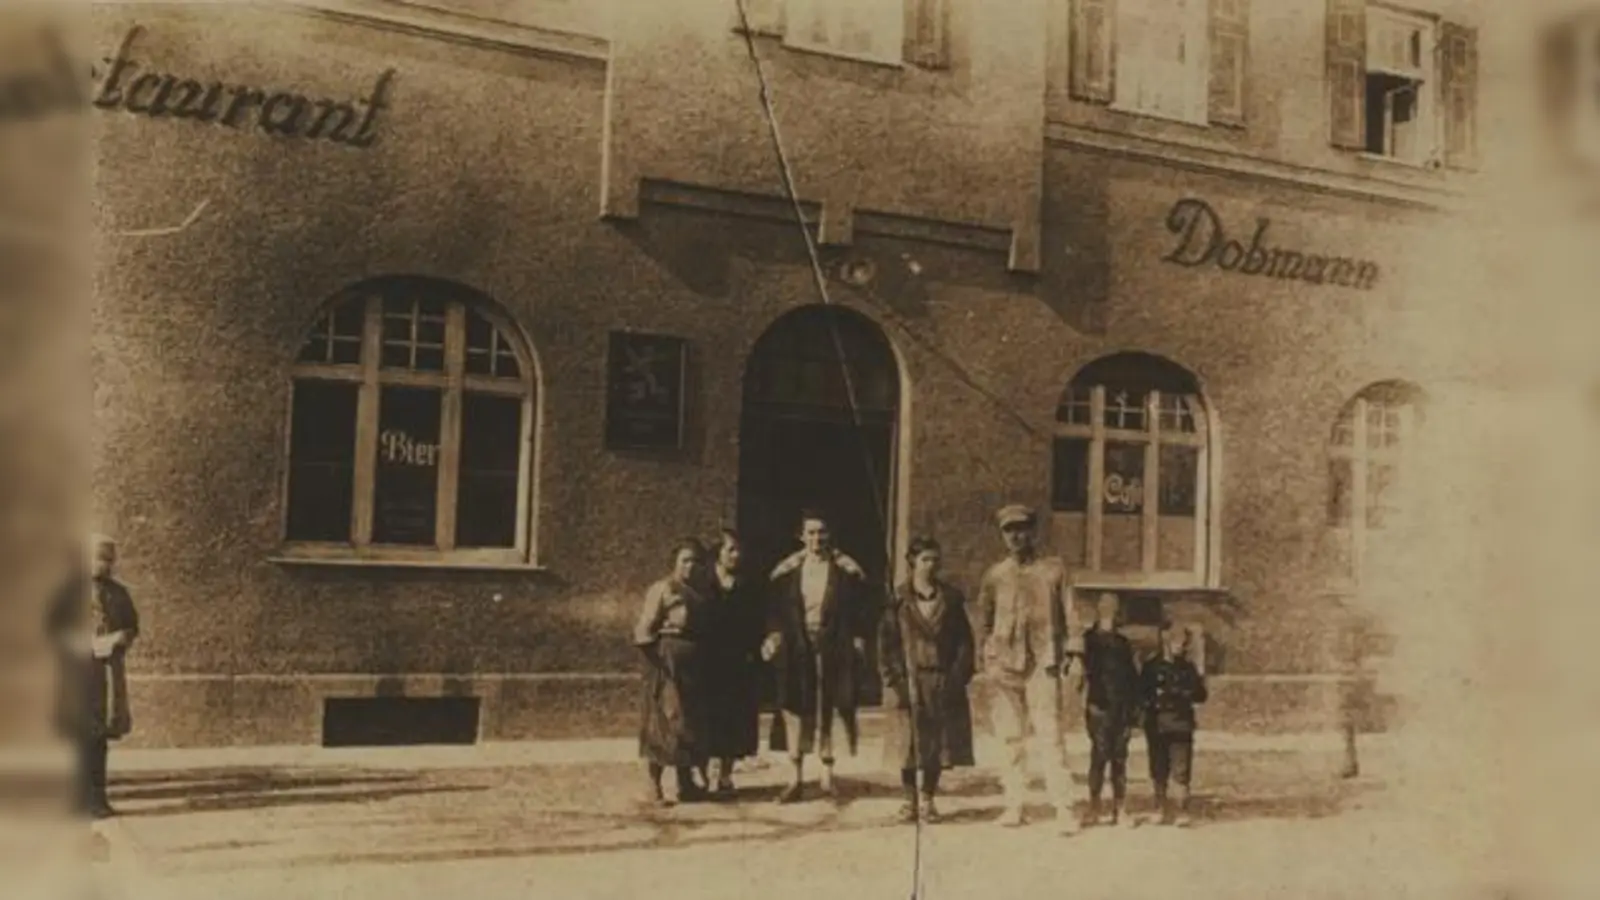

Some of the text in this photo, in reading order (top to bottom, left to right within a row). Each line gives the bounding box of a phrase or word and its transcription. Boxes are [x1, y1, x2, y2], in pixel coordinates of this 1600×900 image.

[91, 24, 396, 148] taurant
[1161, 198, 1380, 291] Dobmann
[380, 428, 441, 467] Bier
